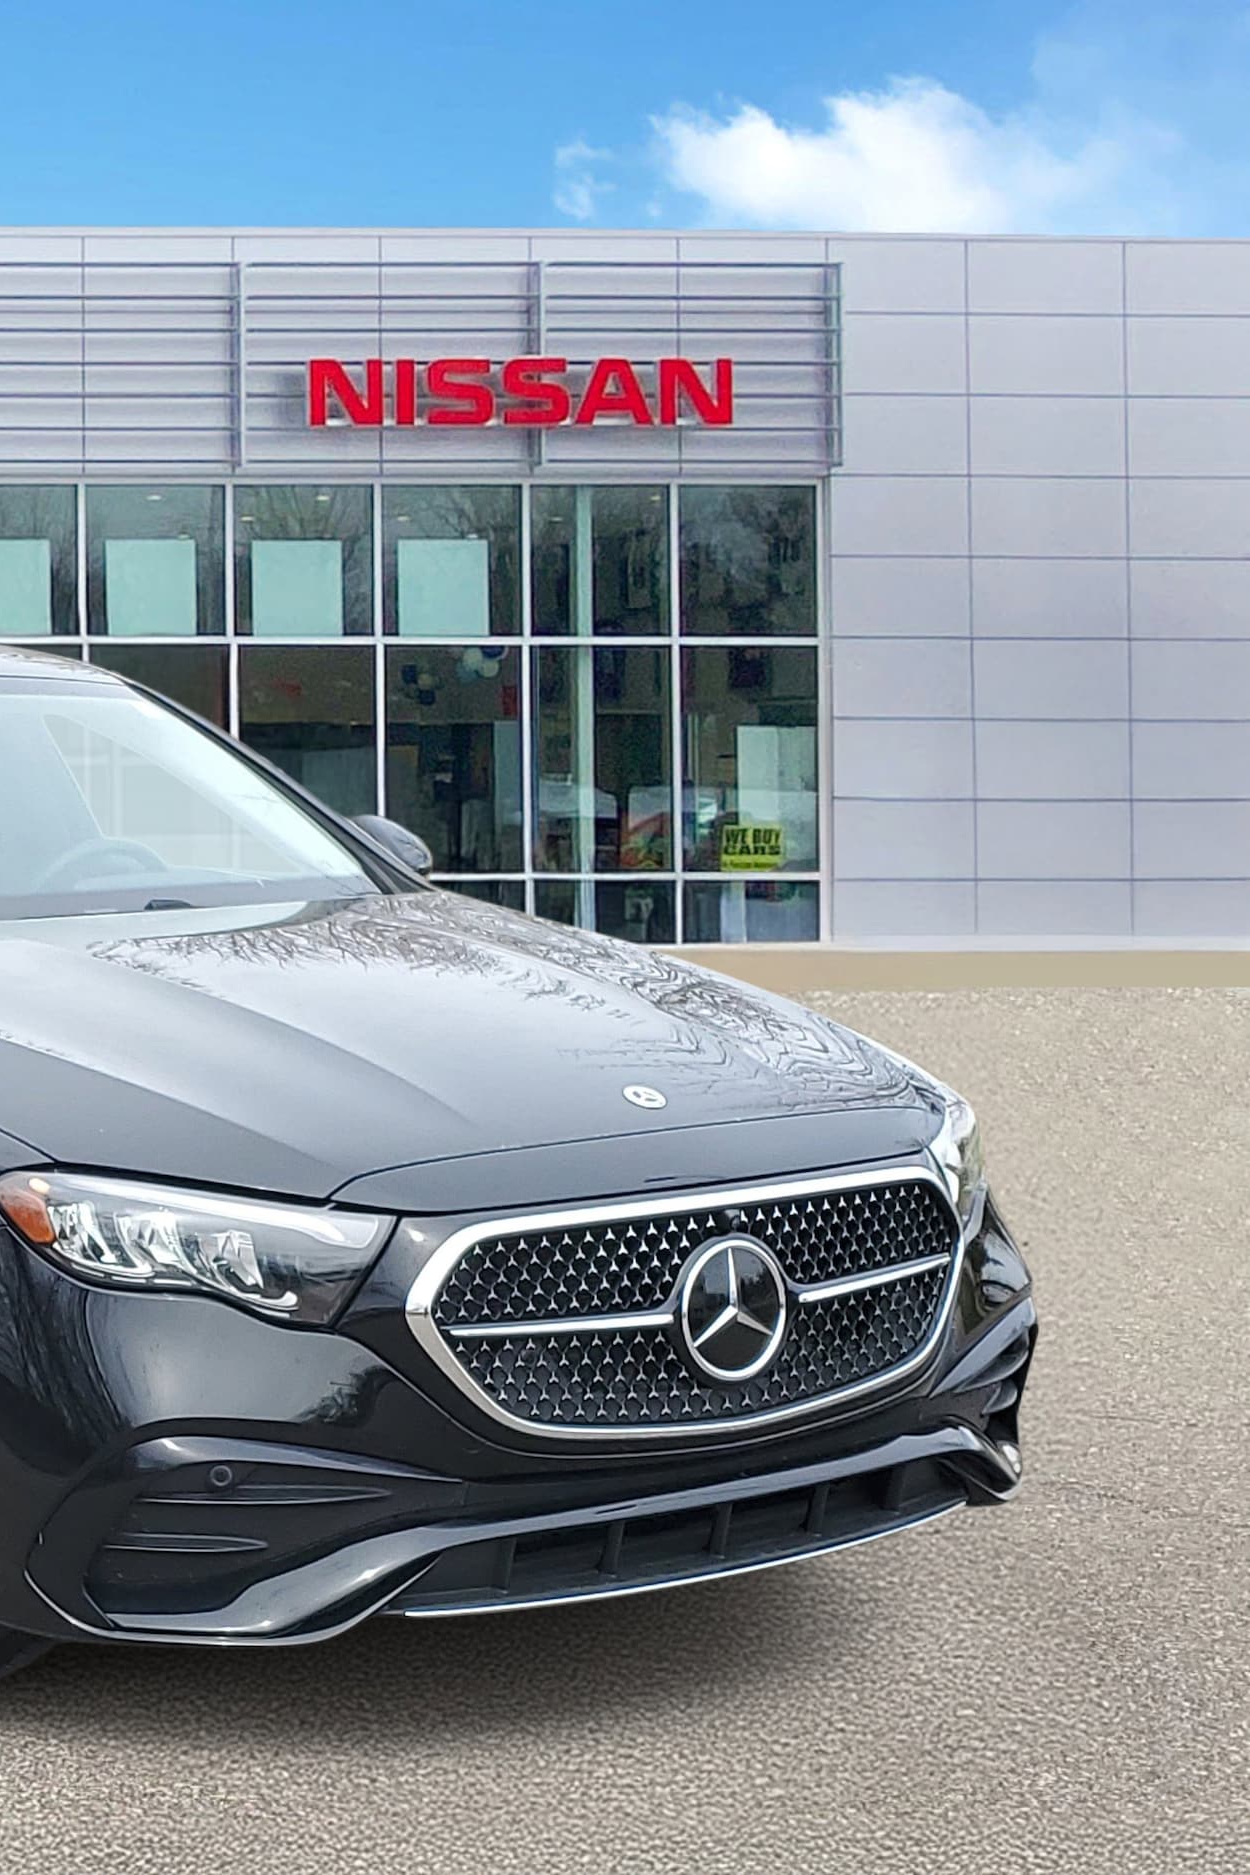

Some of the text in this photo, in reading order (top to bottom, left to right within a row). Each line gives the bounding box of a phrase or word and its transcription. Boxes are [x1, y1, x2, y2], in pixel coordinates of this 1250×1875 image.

[308, 357, 733, 426] NISSAN
[725, 828, 781, 844] WE BUY
[723, 845, 781, 855] CARS
